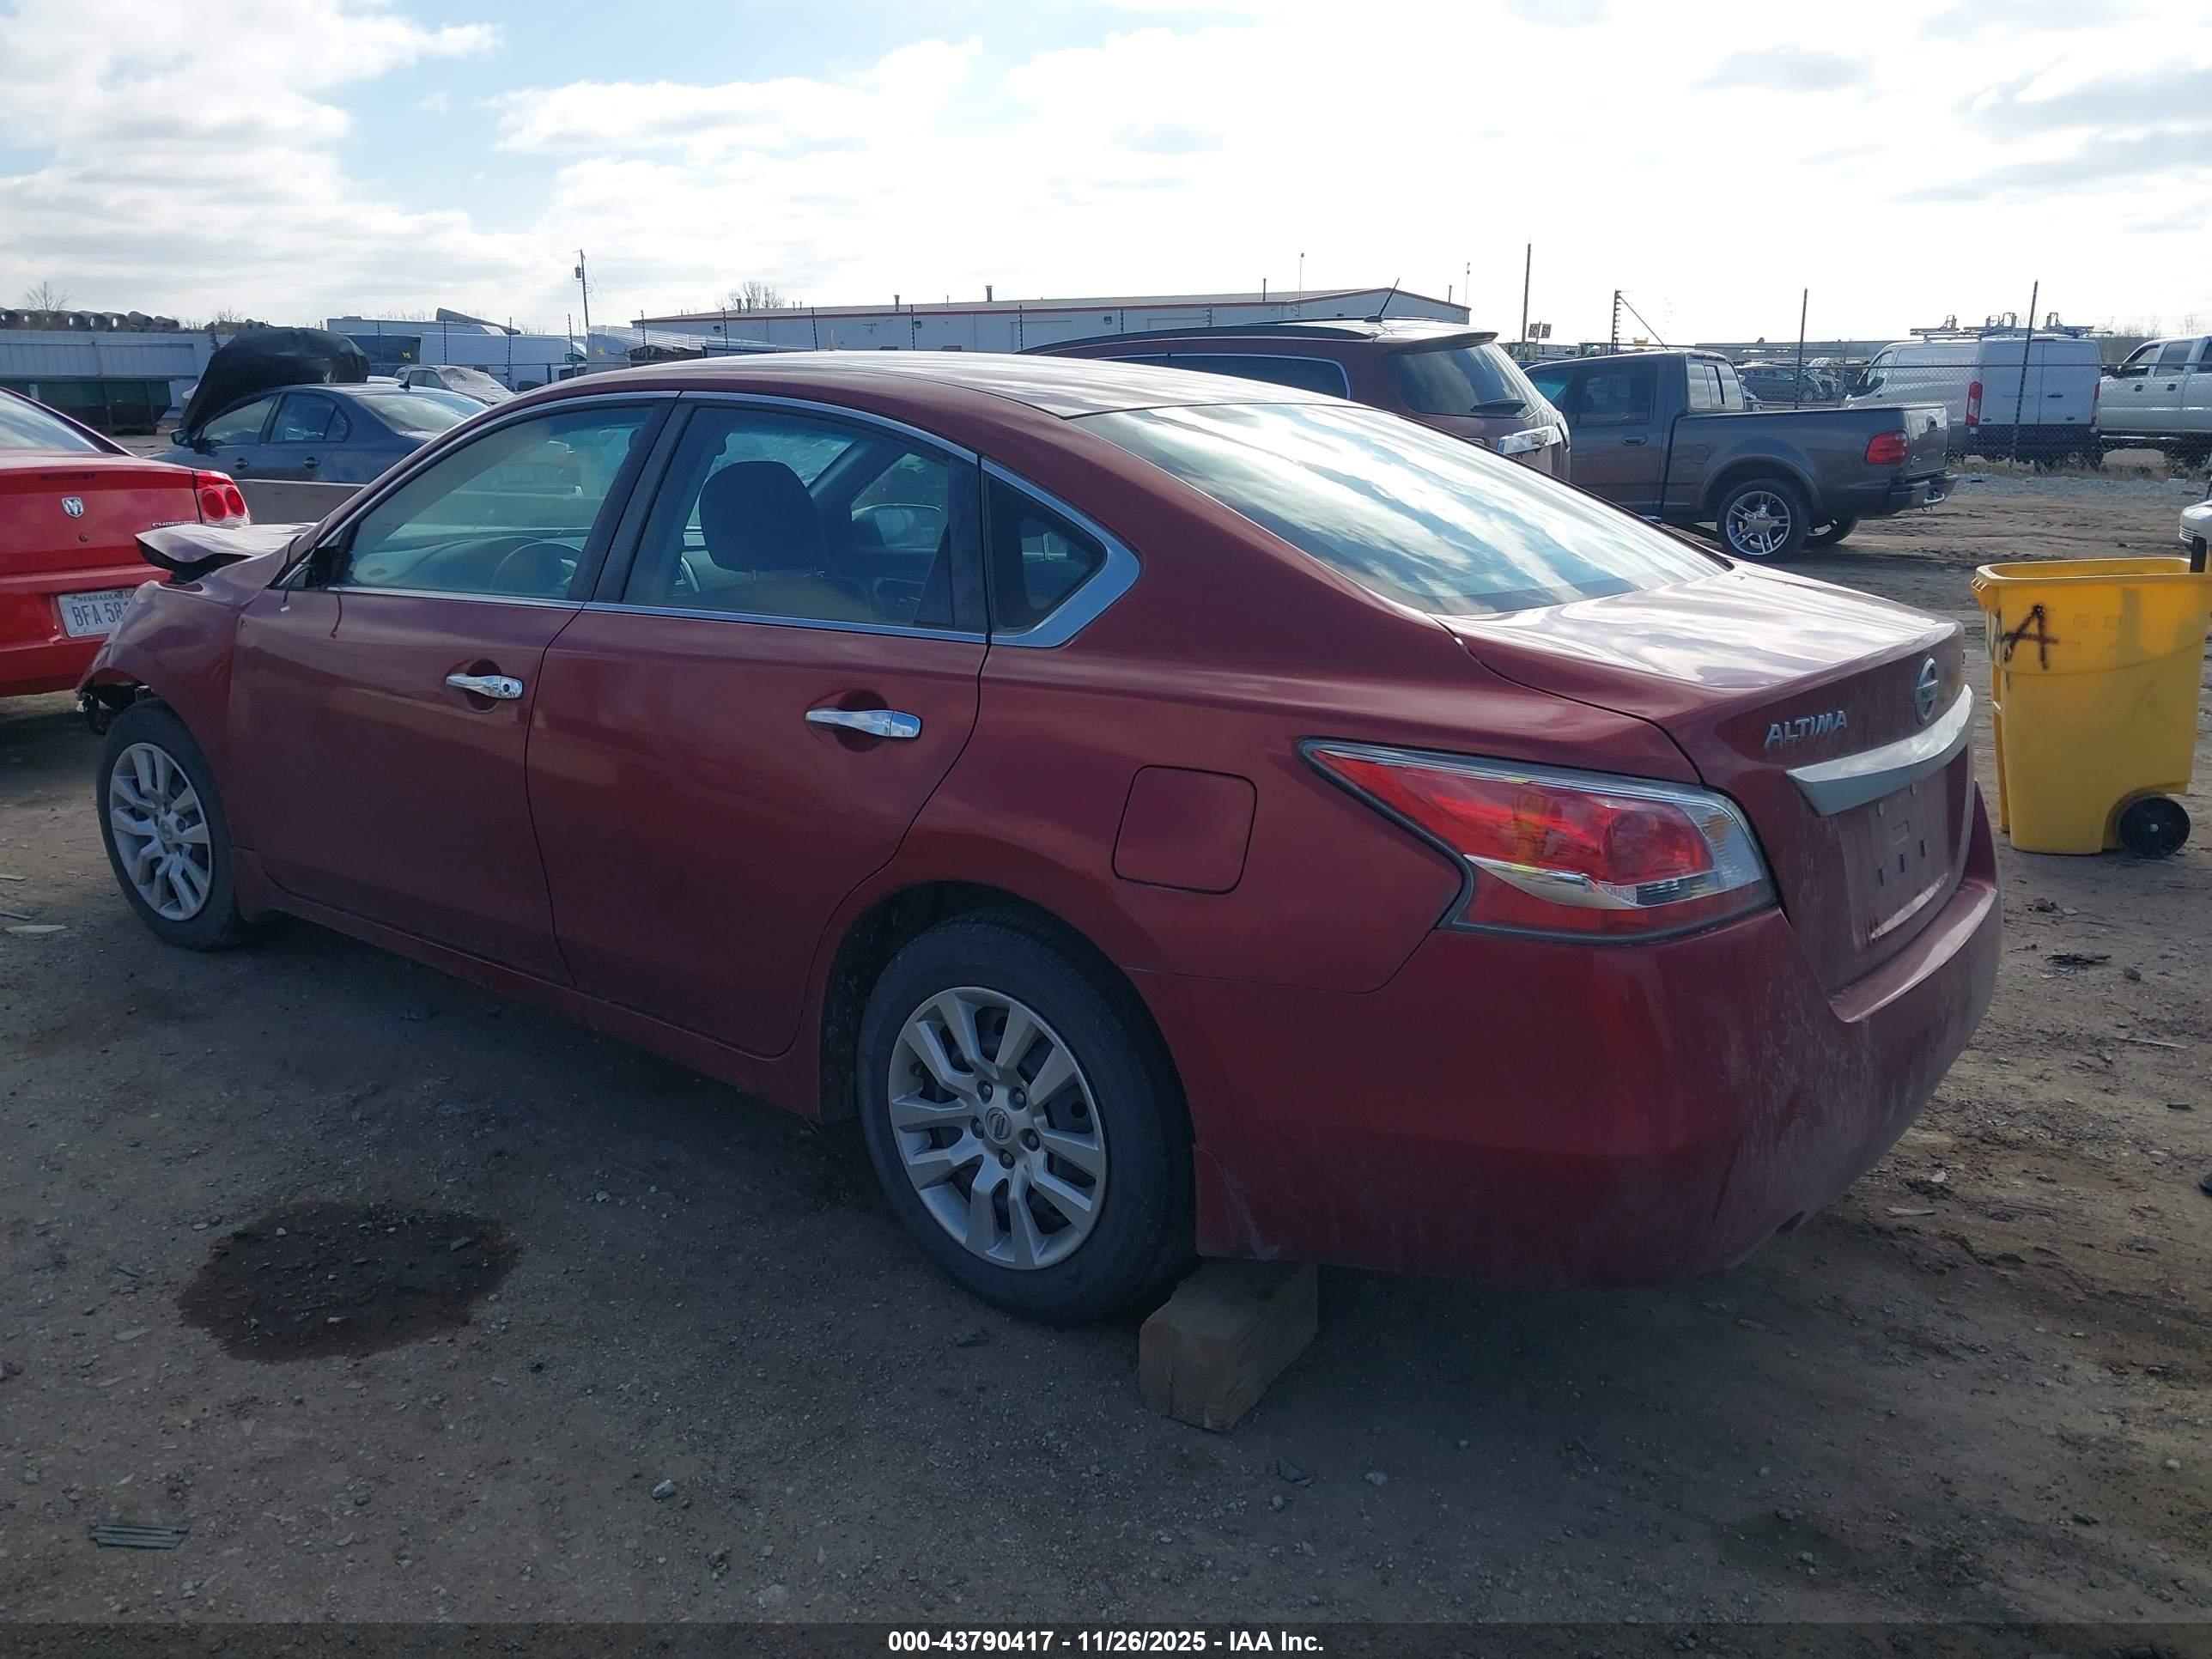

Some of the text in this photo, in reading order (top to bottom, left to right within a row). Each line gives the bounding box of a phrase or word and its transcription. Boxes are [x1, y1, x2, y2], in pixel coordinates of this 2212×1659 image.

[71, 601, 129, 627] BFA 58
[1996, 604, 2059, 672] A
[1764, 710, 1848, 748] ALTIMA
